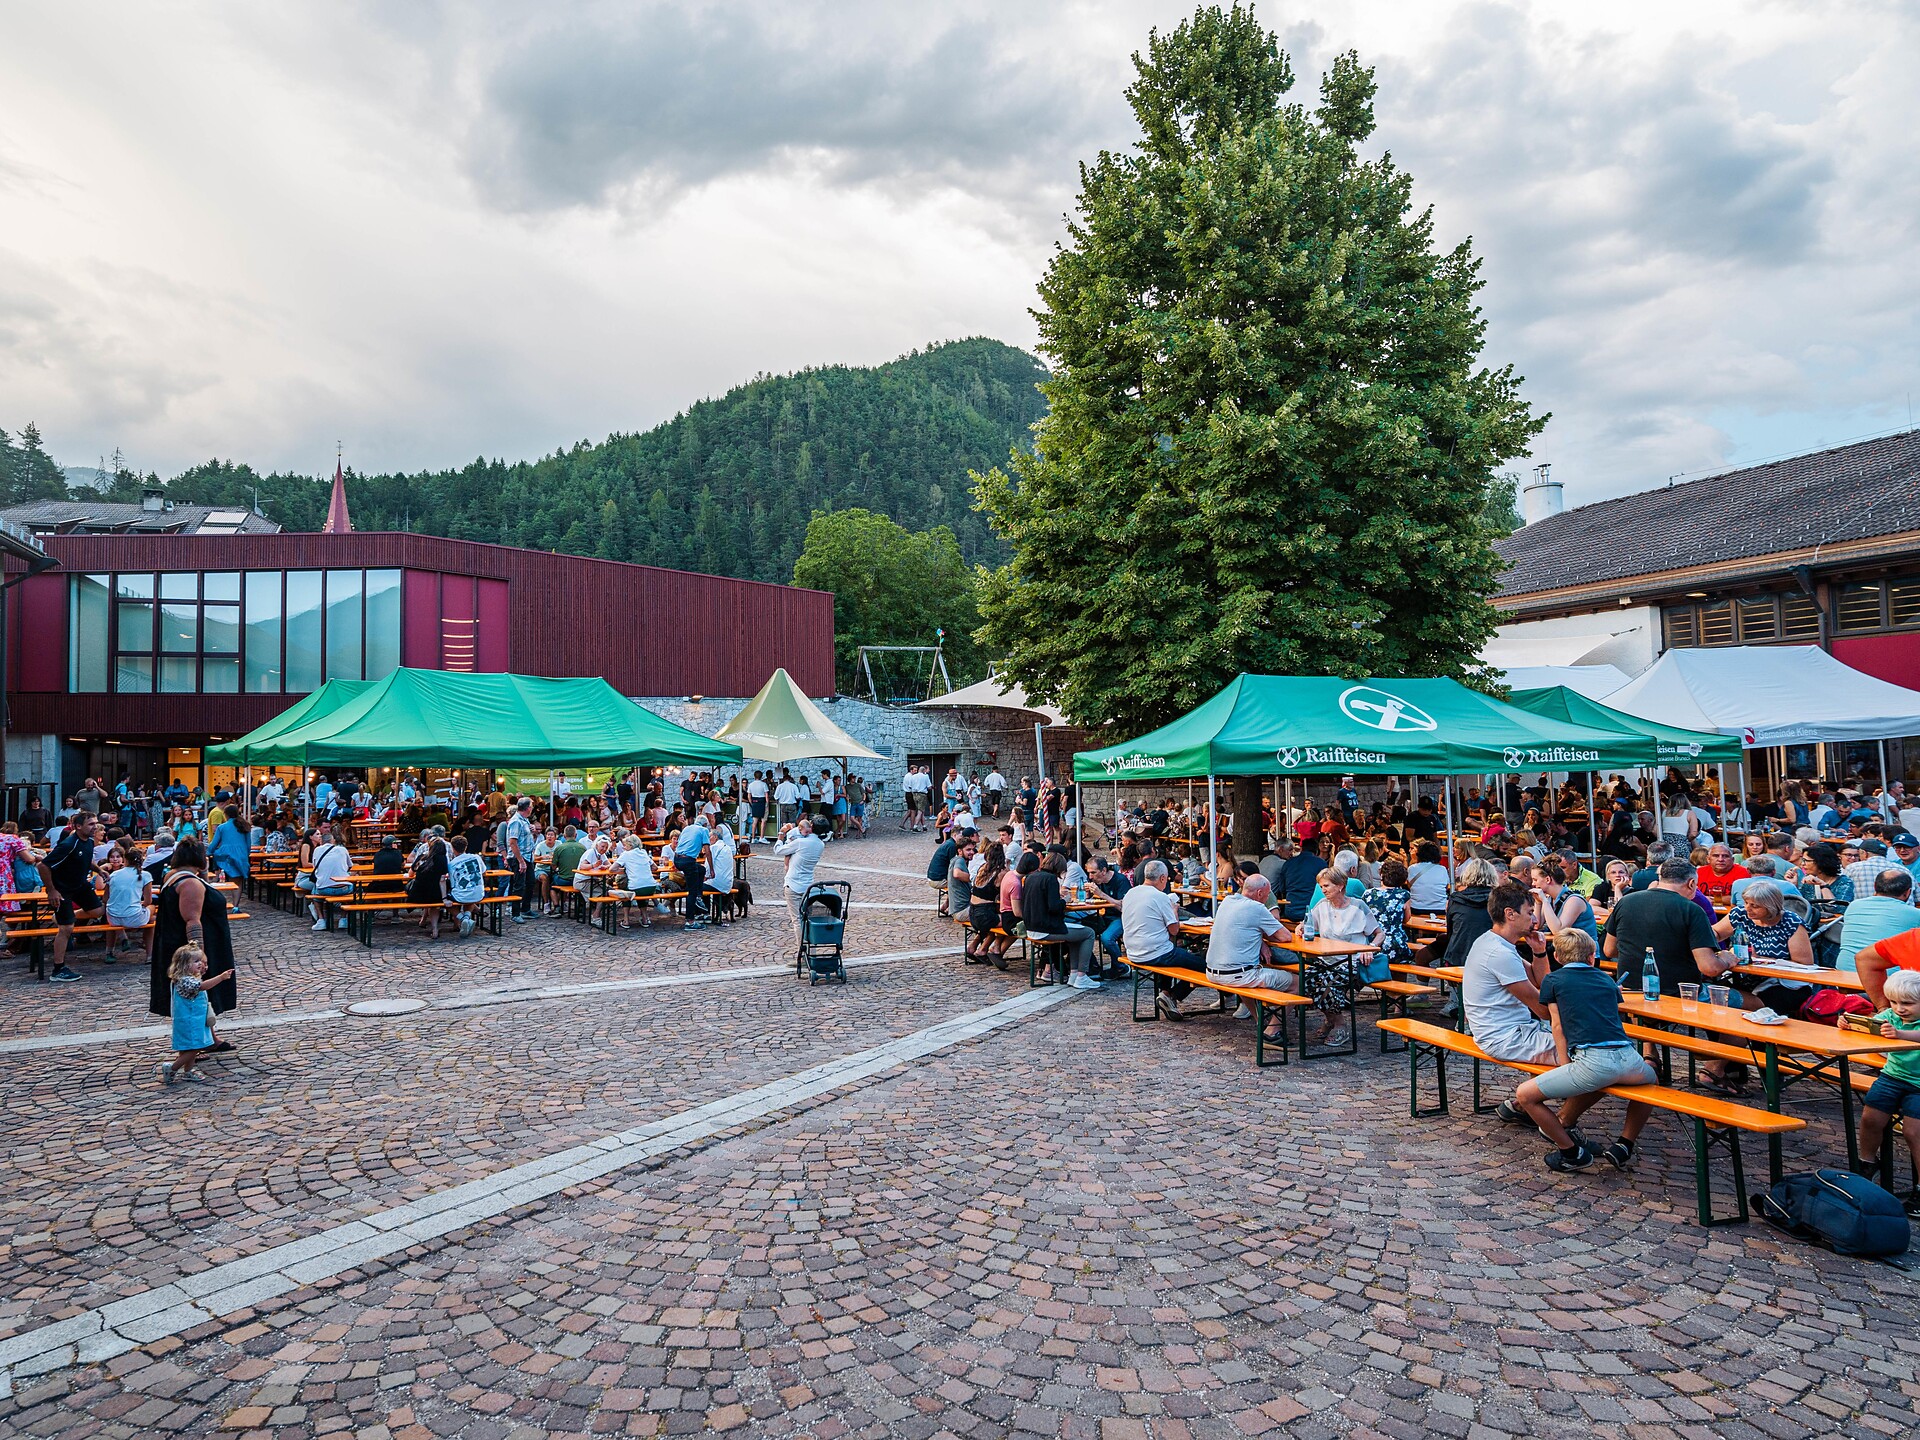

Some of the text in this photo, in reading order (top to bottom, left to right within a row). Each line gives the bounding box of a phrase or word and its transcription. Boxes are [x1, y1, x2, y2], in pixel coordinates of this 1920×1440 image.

[1758, 727, 1818, 740] Gemeinde Kiens
[1305, 746, 1387, 763] Raiffeisen
[1526, 747, 1600, 762] Raiffeisen
[1656, 745, 1676, 753] feisen
[1117, 754, 1165, 770] Raiffeisen
